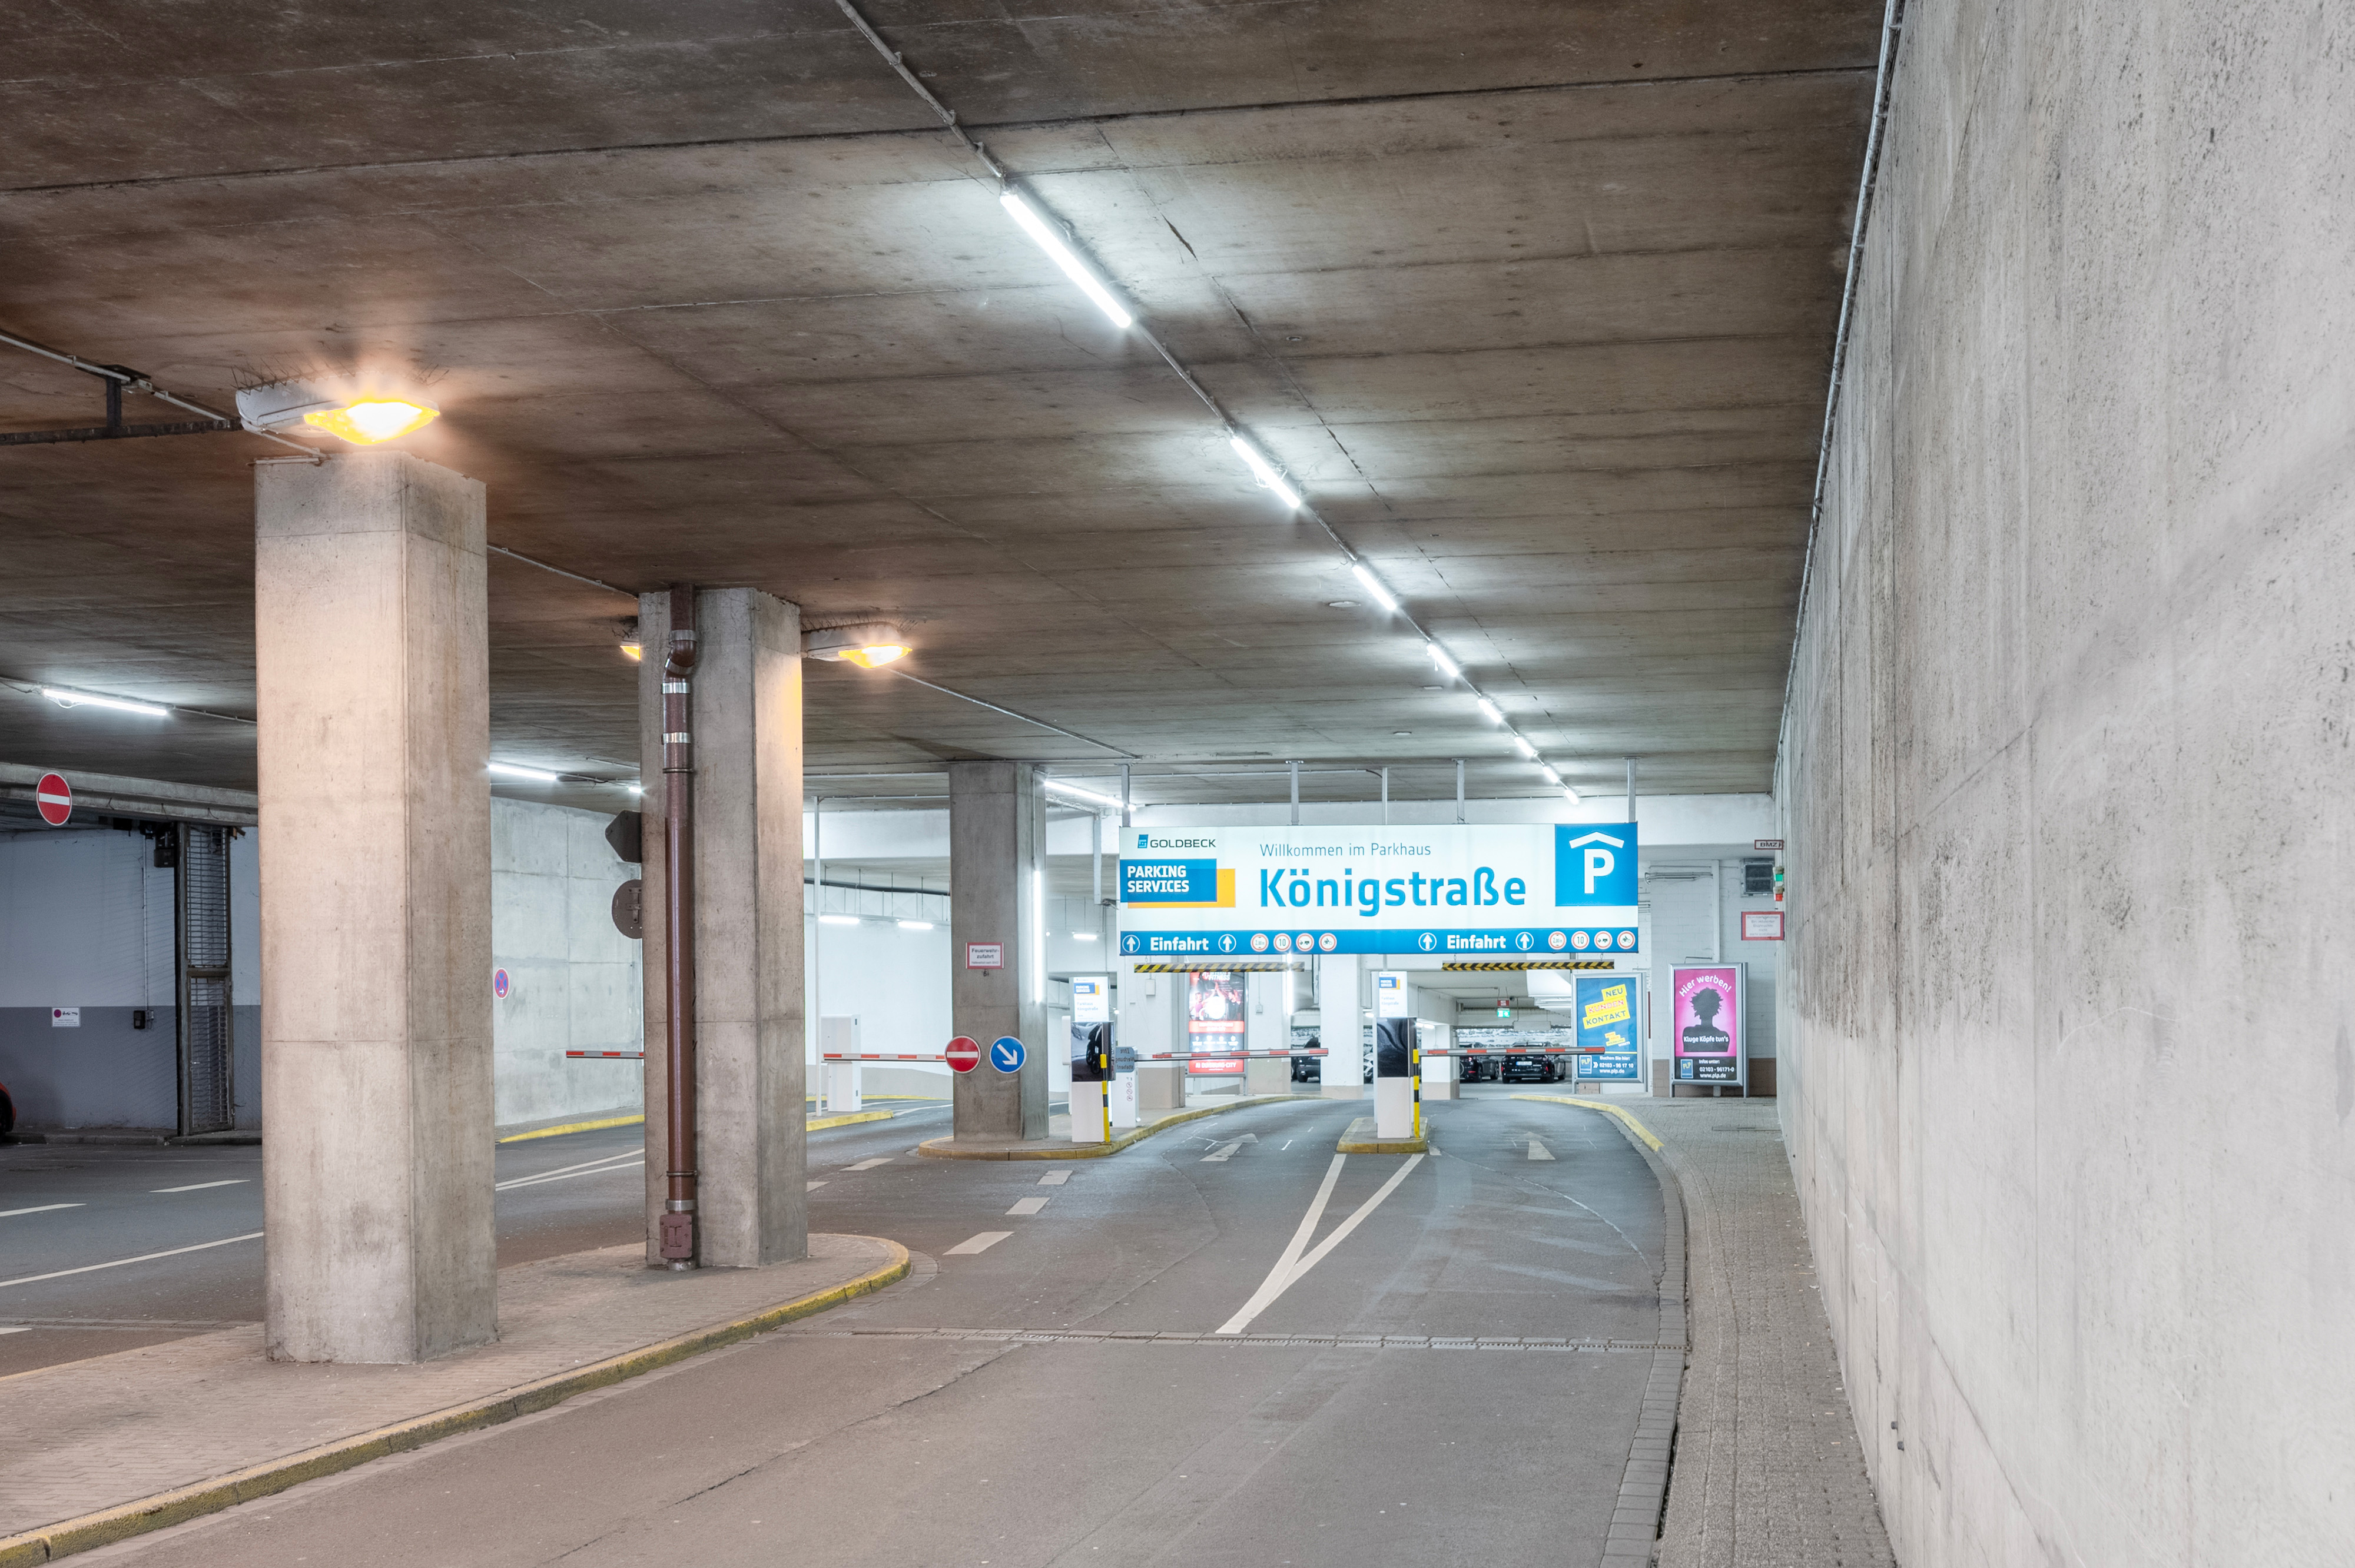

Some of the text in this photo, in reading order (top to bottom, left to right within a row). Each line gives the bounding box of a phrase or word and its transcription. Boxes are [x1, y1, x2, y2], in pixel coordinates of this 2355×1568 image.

[1150, 839, 1216, 848] GOLDBECK
[1260, 842, 1431, 856] Willkommen im Parkhaus
[1127, 865, 1186, 878] PARKING
[1584, 848, 1614, 894] P
[1127, 880, 1189, 892] SERVICES
[1260, 866, 1526, 916] Königstraße
[1150, 936, 1209, 951] Einfahrt
[1447, 935, 1506, 949] Einfahrt
[1606, 987, 1623, 997] NEU
[1679, 975, 1732, 997] Hier werben!
[1588, 999, 1624, 1014] KUNDEN
[1586, 1010, 1626, 1025] KONTAKT
